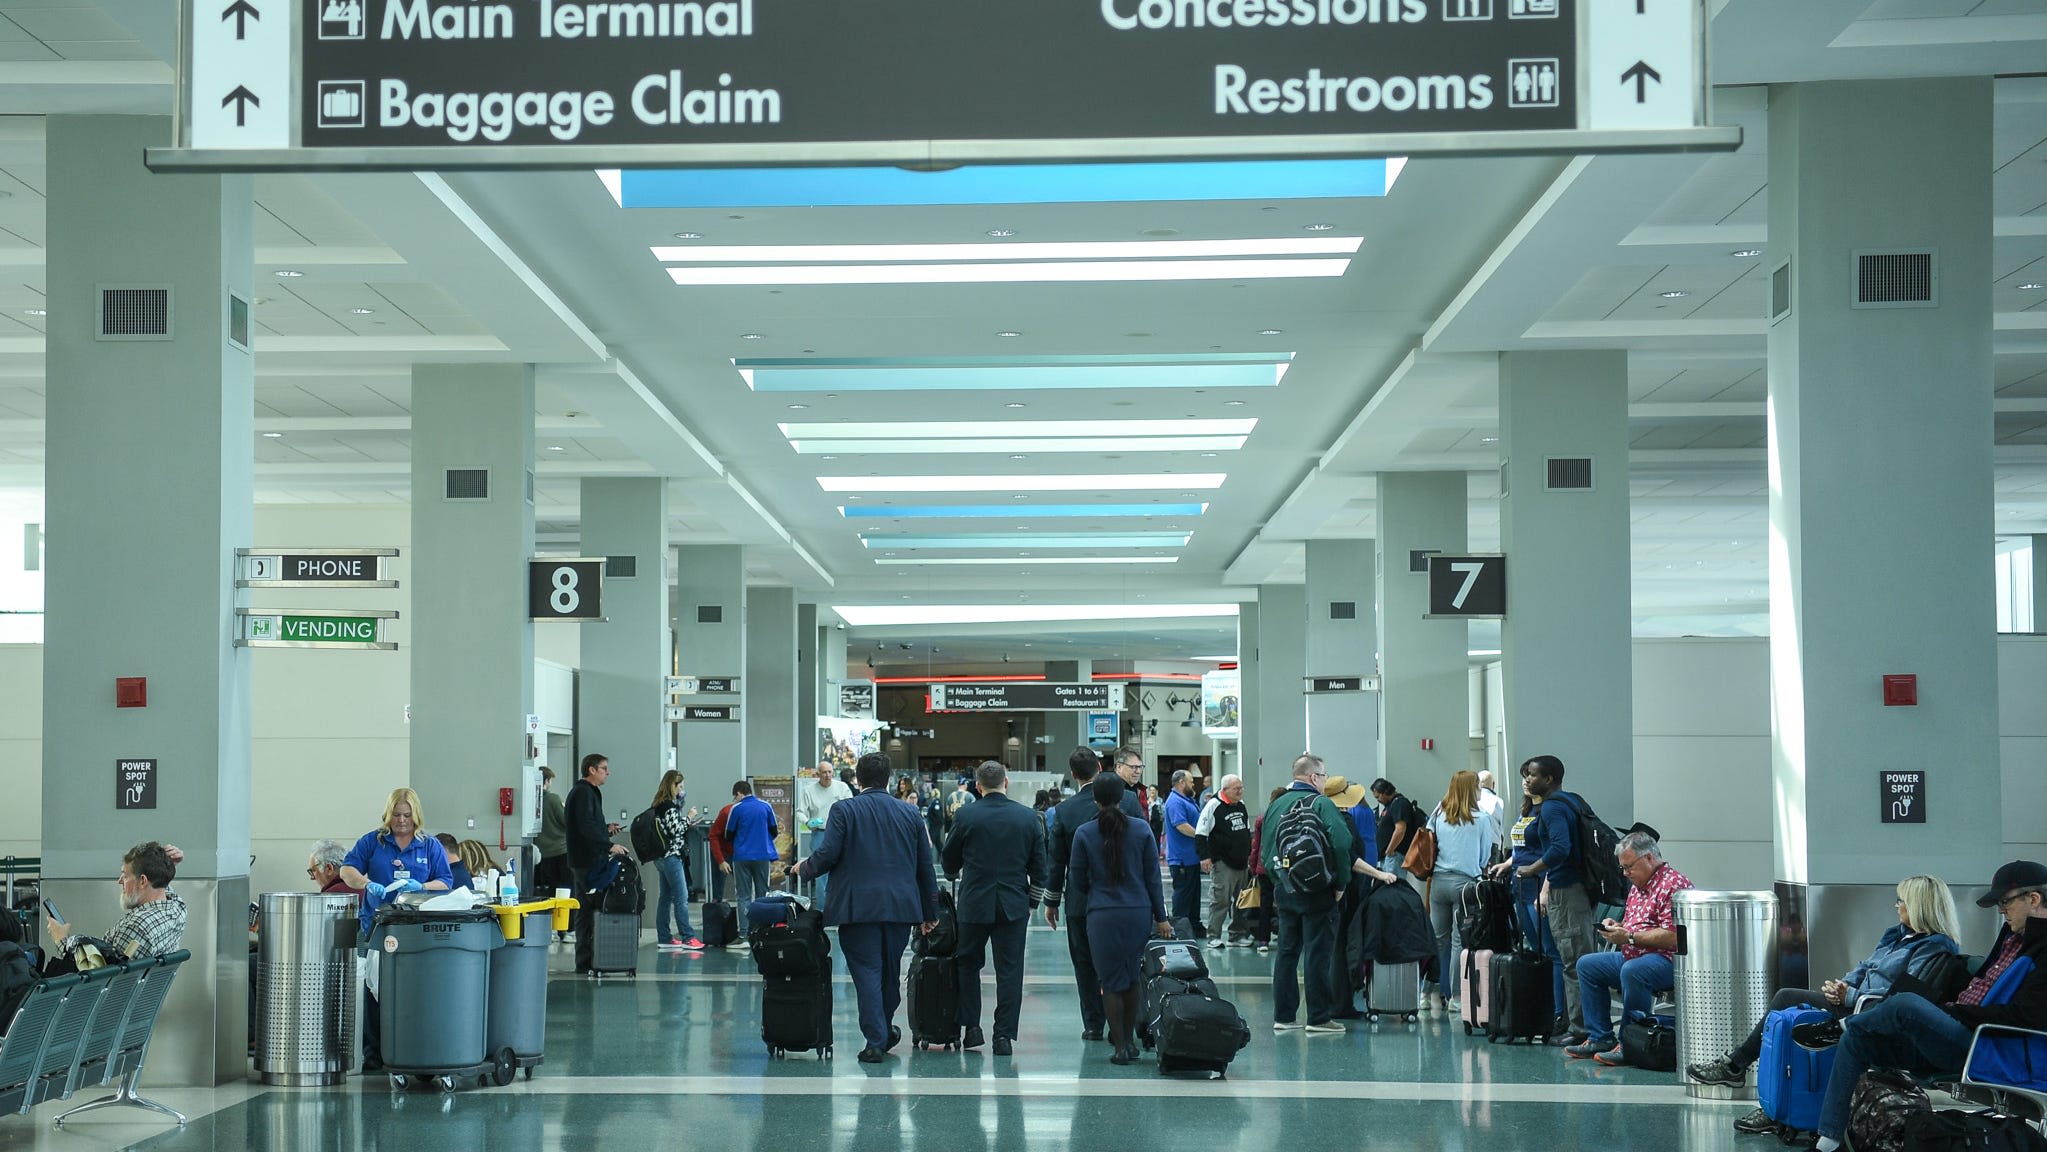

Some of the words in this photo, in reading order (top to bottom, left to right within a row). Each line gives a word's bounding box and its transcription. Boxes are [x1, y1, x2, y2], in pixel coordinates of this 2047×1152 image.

[381, 0, 513, 40] Main
[540, 0, 753, 38] Terminal
[1101, 0, 1427, 30] Concessions
[1215, 65, 1494, 114] Restrooms
[380, 79, 615, 142] Baggage
[631, 70, 781, 126] Claim
[298, 560, 362, 576] PHONE
[550, 566, 579, 614] 8
[1451, 562, 1485, 610] 7
[285, 621, 373, 638] VENDING
[1329, 681, 1345, 689] Men
[975, 687, 1005, 695] Terminal
[1055, 687, 1076, 695] Gates
[1078, 687, 1082, 695] 1
[1084, 687, 1092, 695] to
[1093, 687, 1099, 695] 6
[955, 699, 987, 709] Baggage
[987, 698, 1009, 707] Claim
[1063, 698, 1099, 707] Restaurant
[694, 709, 722, 717] Women
[121, 762, 151, 771] POWER
[125, 771, 147, 780] SPOT
[1886, 774, 1919, 783] POWER
[1891, 784, 1915, 793] SPOT
[423, 923, 462, 933] BRUTE
